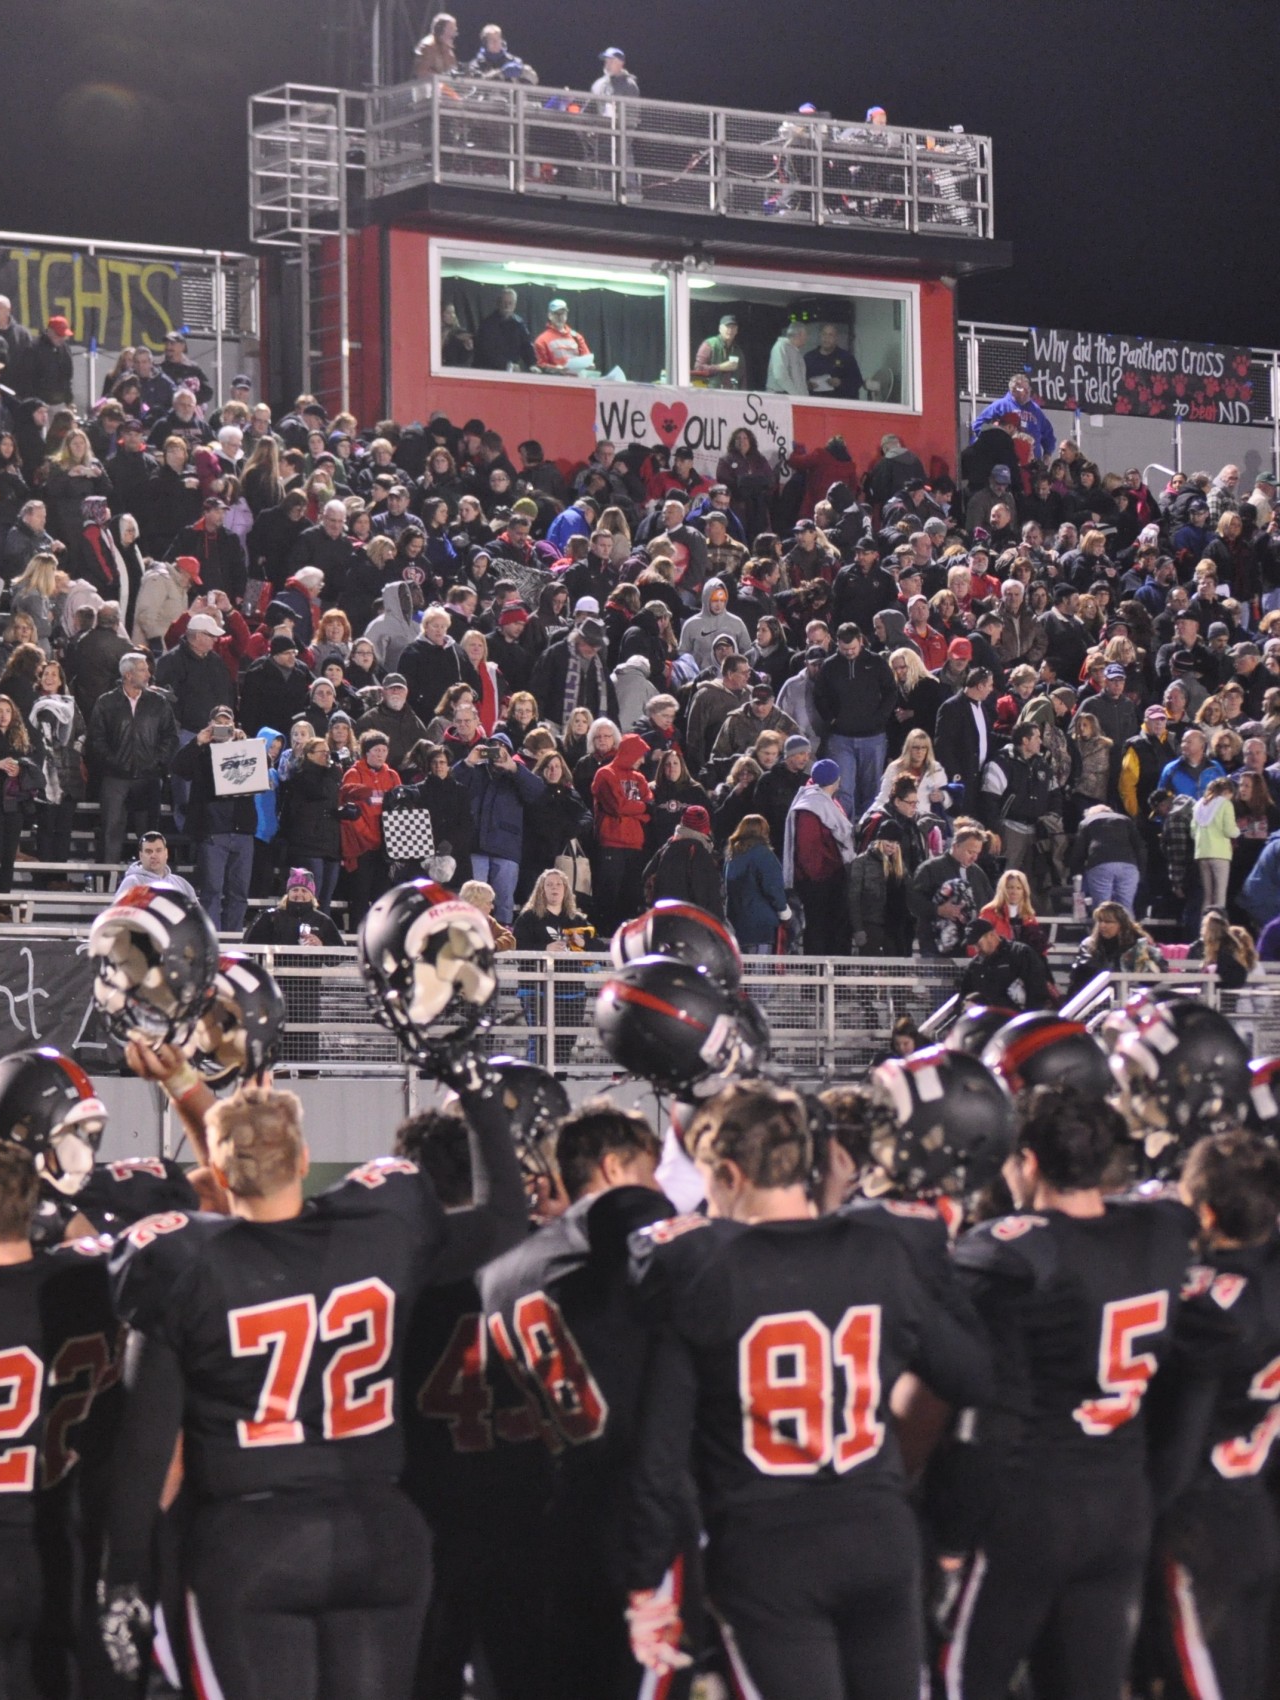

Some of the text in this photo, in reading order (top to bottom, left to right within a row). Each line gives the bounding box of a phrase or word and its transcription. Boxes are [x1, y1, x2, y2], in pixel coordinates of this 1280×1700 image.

[1031, 328, 1225, 378] Why did the Panthers Cross
[1031, 364, 1123, 406] the field?
[599, 399, 647, 441] We
[683, 415, 727, 451] our
[1173, 400, 1251, 424] to beat ND
[228, 1276, 396, 1449] 72
[1072, 1289, 1169, 1435] 5
[738, 1304, 886, 1476] 81
